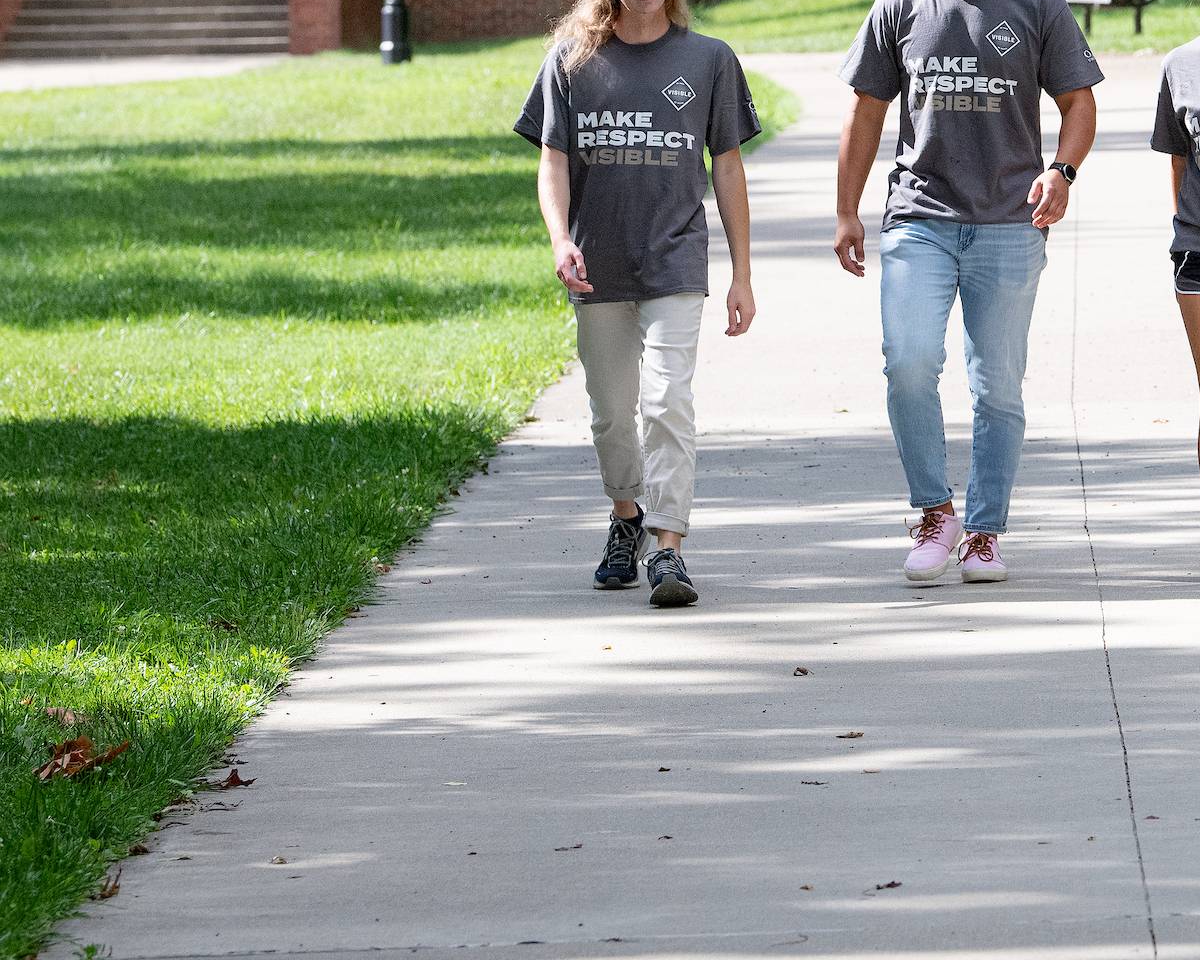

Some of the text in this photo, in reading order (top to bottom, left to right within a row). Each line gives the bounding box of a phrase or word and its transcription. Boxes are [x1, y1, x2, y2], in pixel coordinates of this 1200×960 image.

[991, 33, 1015, 44] VISIBLE
[909, 56, 978, 74] MAKE
[667, 89, 692, 98] VISIBLE
[914, 75, 1018, 96] RESPECT
[915, 95, 1002, 113] VSIBLE
[577, 110, 653, 129] MAKE
[577, 129, 696, 150] RESPECT
[578, 149, 679, 167] VISIBLE
